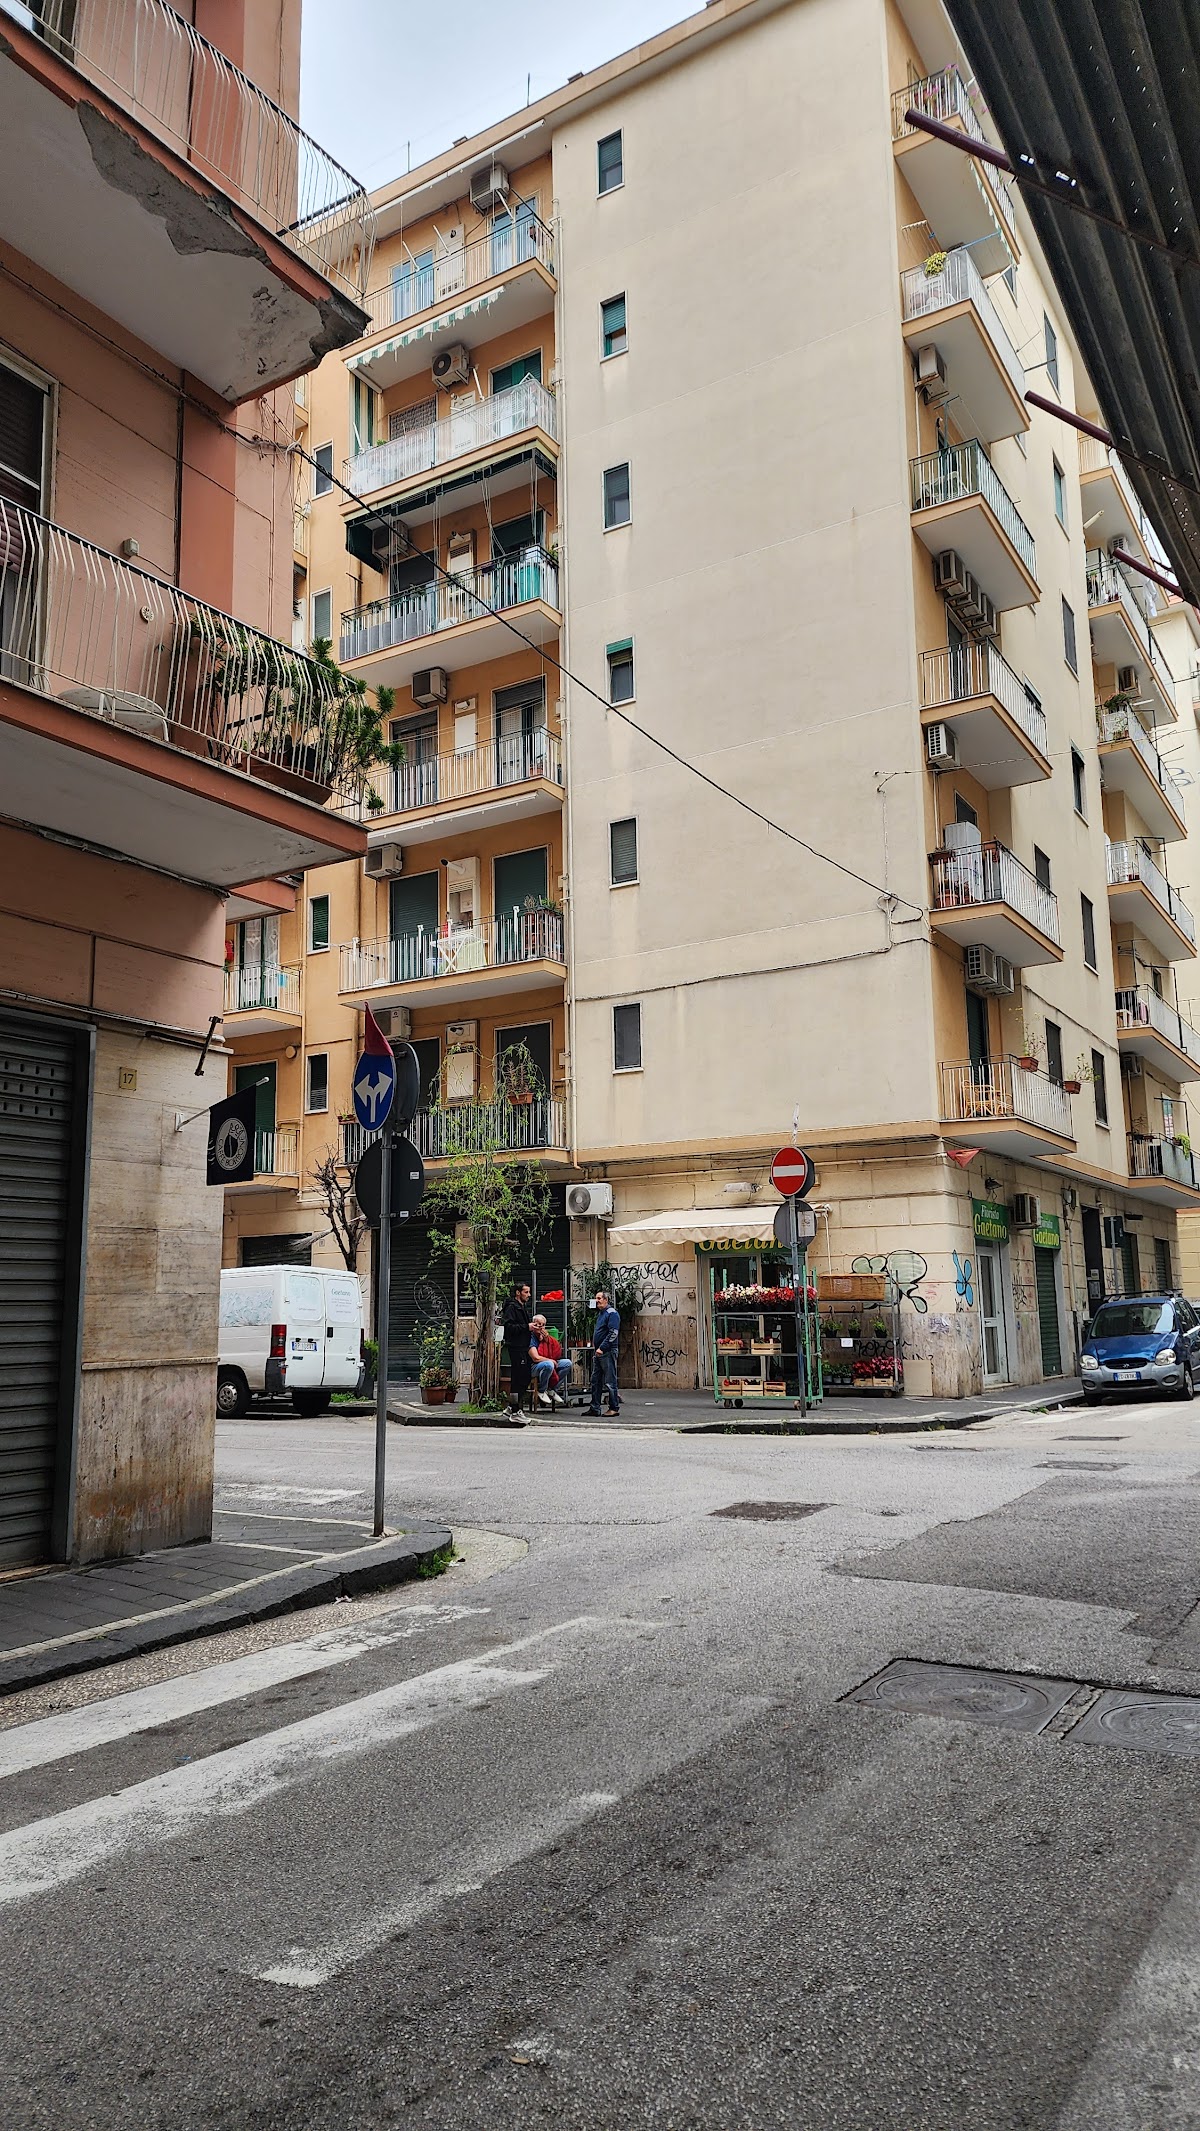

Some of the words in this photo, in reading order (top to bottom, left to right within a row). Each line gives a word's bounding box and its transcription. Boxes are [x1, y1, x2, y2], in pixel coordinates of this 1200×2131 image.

[123, 1072, 134, 1084] 17
[974, 1213, 1007, 1240] Gaetano
[698, 1235, 784, 1252] Gaetan
